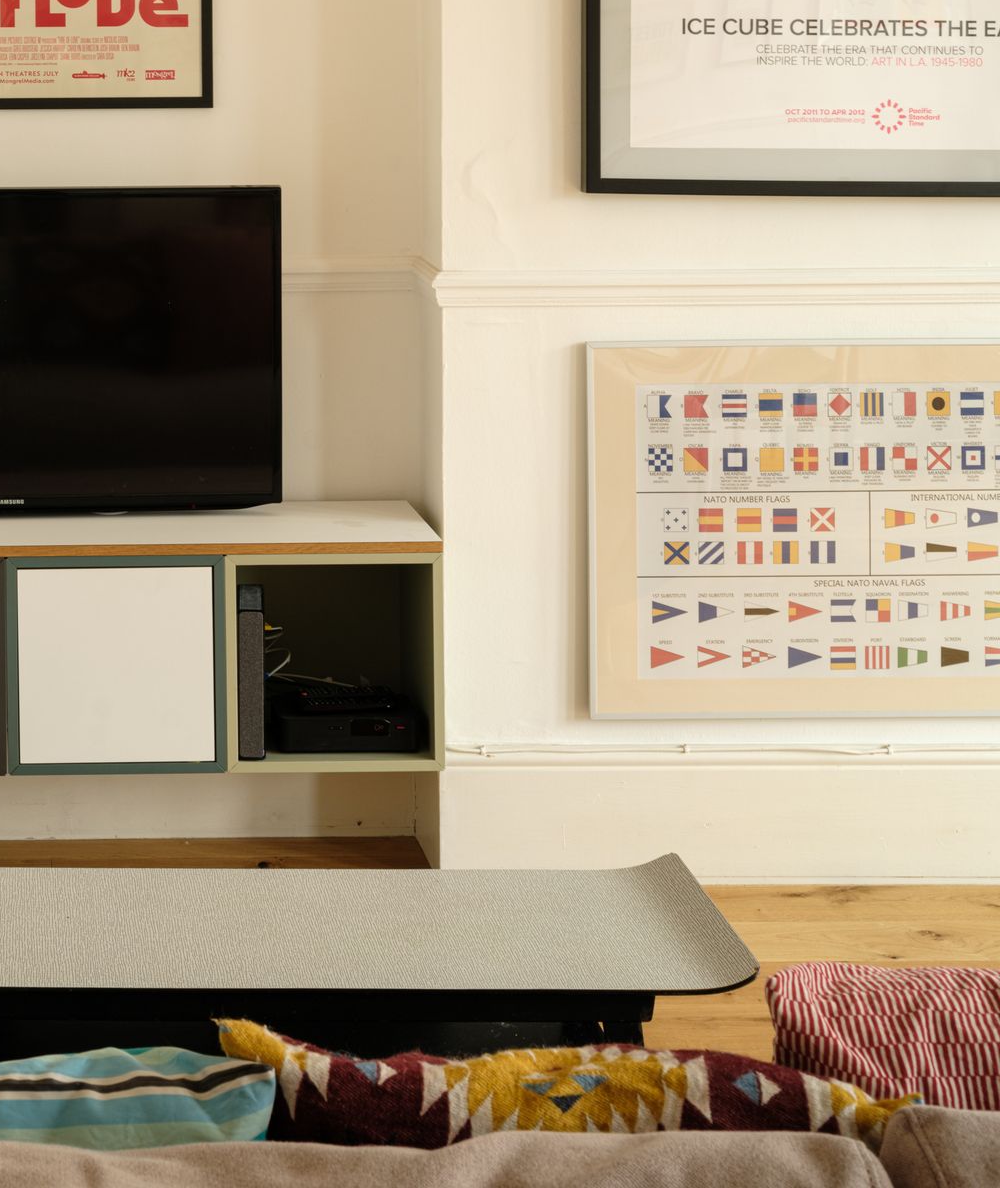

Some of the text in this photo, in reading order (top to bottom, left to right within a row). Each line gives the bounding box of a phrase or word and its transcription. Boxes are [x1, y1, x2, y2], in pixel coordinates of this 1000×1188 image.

[682, 18, 1000, 37] ICE CUBE CELEBRATES THE E
[756, 44, 984, 55] CELEBRATE THE ERA THAT CONTINUES TO
[756, 56, 798, 66] INSPIRE
[801, 56, 823, 66] THE
[871, 57, 893, 66] ART
[896, 57, 907, 66] IN
[931, 57, 983, 67] 1945-1980
[117, 68, 136, 78] mk2
[785, 108, 800, 116] OCT
[819, 108, 830, 116] TO
[831, 108, 847, 116] APR
[703, 495, 791, 504] NATO NUMBER FLAGS
[911, 493, 975, 501] INTERNATIONAL
[813, 578, 926, 587] SPECIAL NATO NAVAL FLAGS
